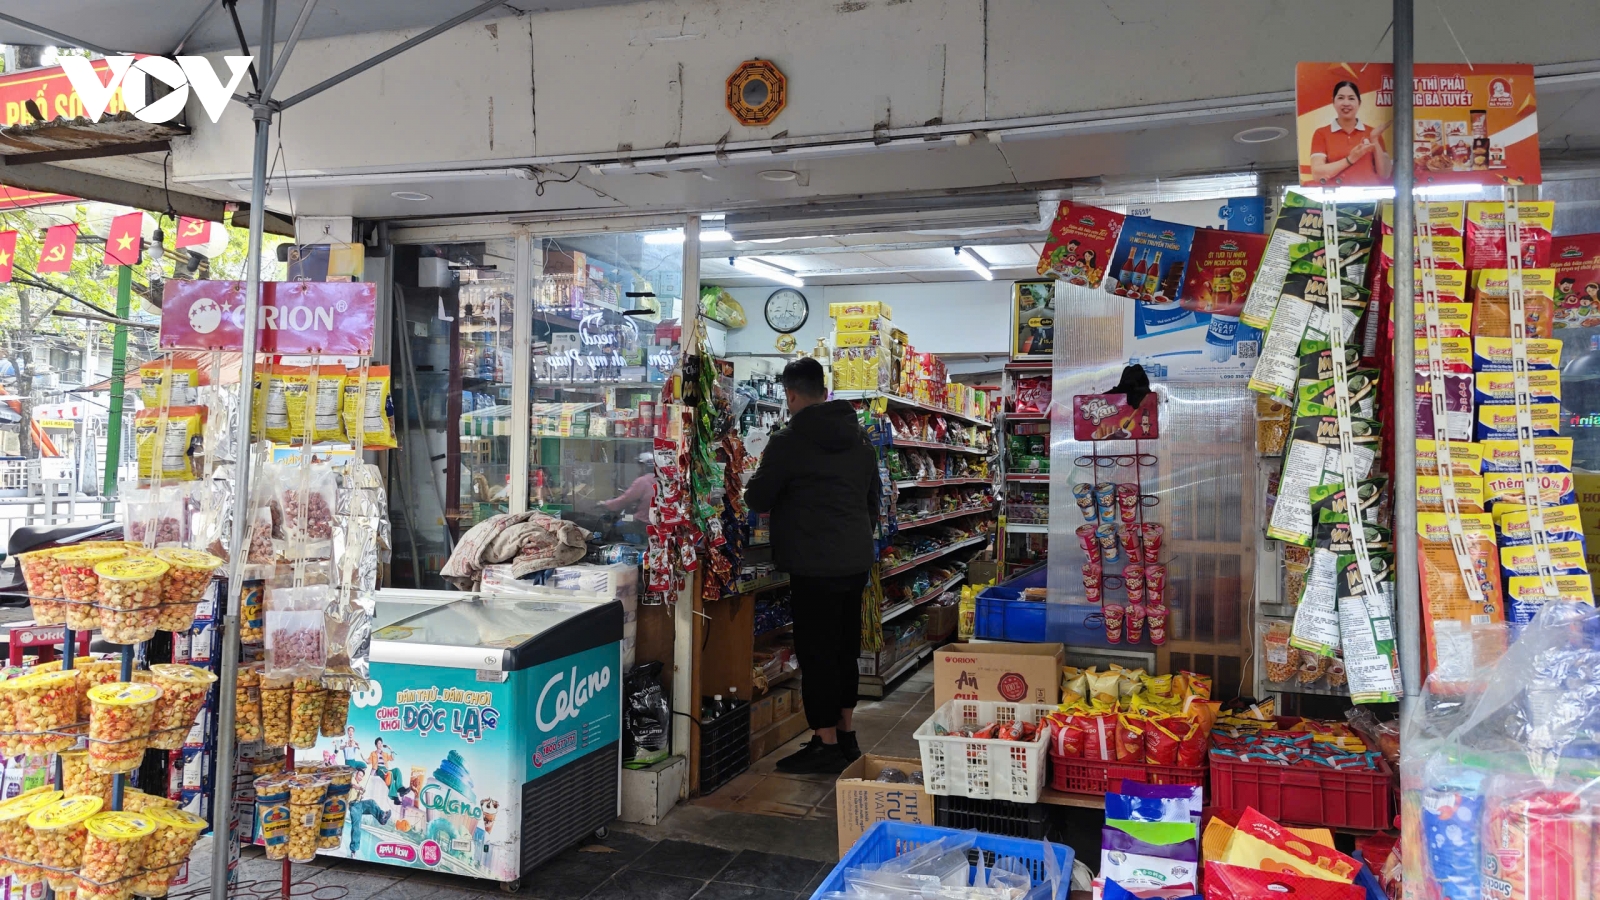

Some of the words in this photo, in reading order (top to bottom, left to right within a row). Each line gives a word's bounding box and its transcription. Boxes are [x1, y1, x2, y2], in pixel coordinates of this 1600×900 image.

[1421, 77, 1438, 90] THÌ
[1440, 75, 1465, 91] PHẢI
[1376, 91, 1393, 106] ĂN
[1425, 92, 1440, 105] BÀ
[1442, 90, 1473, 105] TUYẾT
[1081, 399, 1107, 419] Yan
[1091, 404, 1118, 425] Yan
[1490, 478, 1524, 491] Thêm
[535, 665, 611, 732] Celano
[376, 707, 399, 719] CÙNG
[403, 704, 447, 736] ĐỘC
[452, 708, 482, 743] LẠ
[420, 784, 482, 819] Celano
[875, 791, 885, 823] WATE
[886, 791, 903, 821] tru
[905, 791, 918, 815] TH
